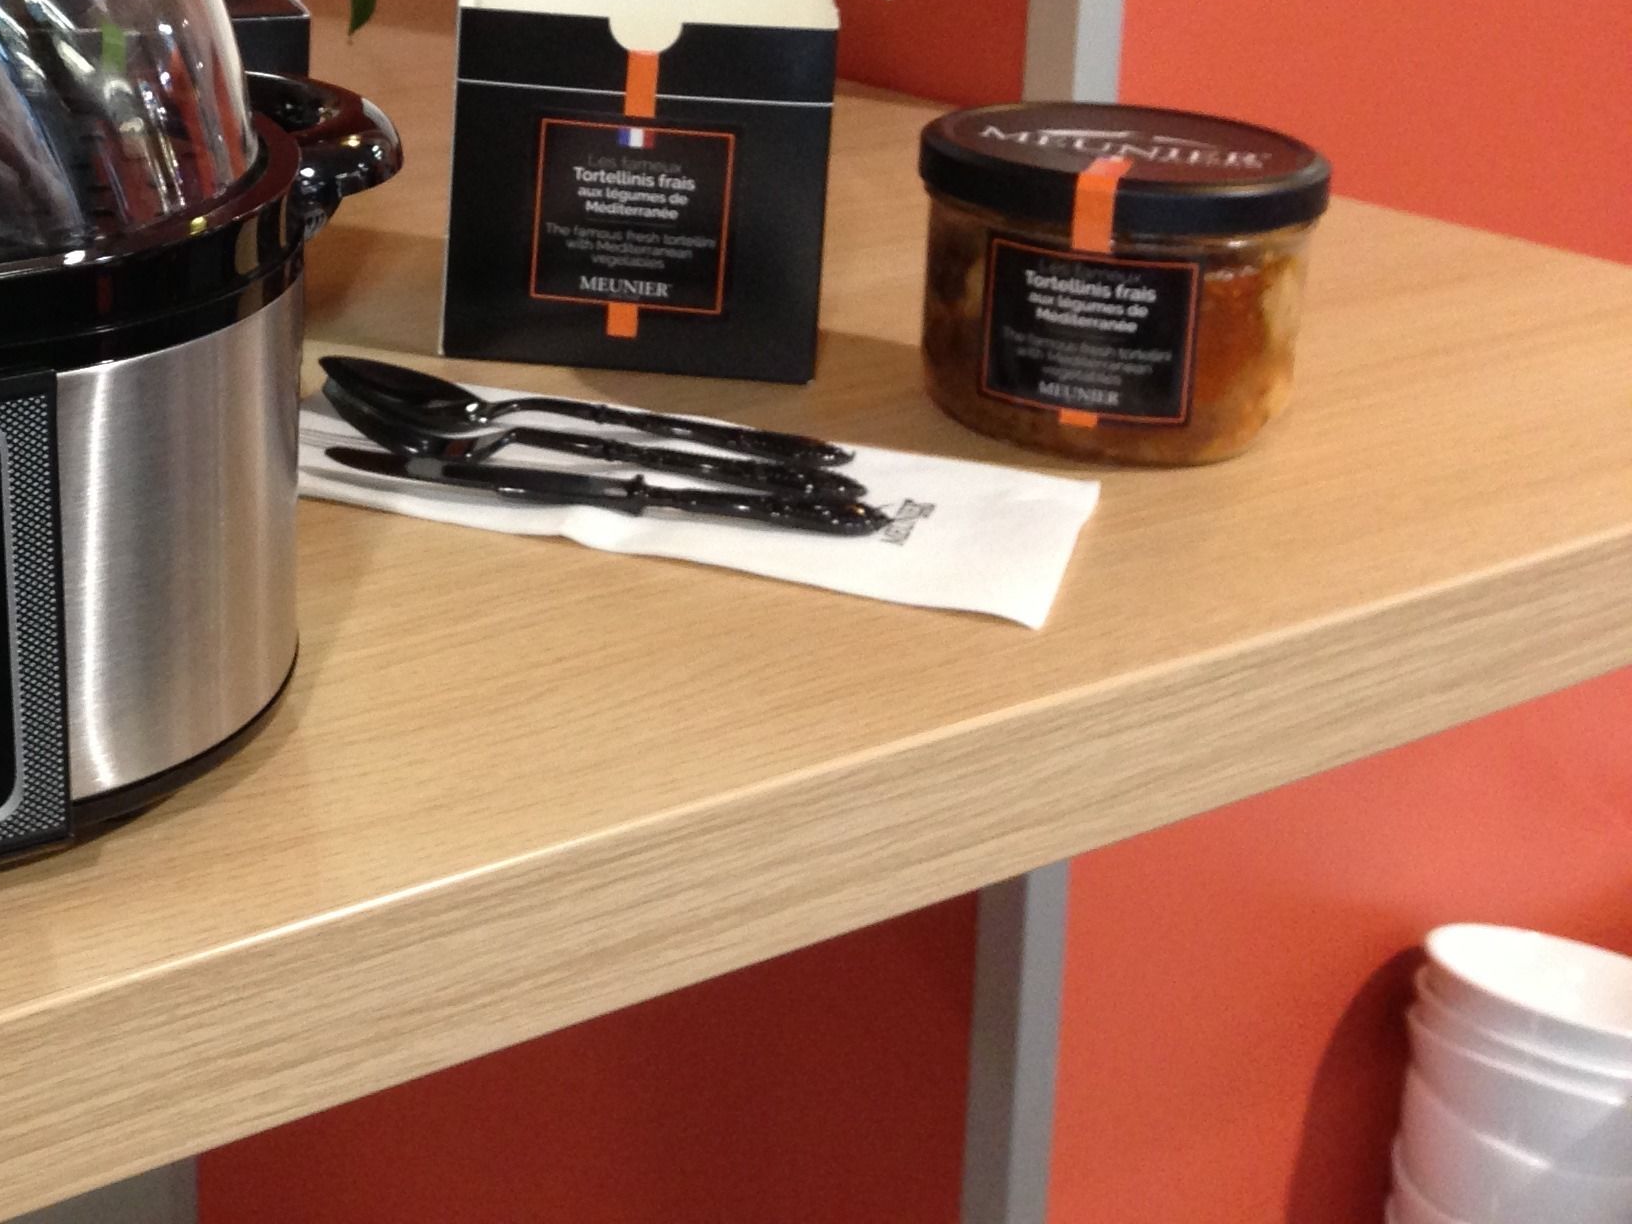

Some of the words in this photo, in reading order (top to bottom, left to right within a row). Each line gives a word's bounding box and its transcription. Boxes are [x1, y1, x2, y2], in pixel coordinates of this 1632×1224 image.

[573, 166, 654, 188] Tortellinis
[658, 174, 696, 192] frais
[578, 187, 602, 198] aux
[669, 193, 689, 206] de
[579, 276, 669, 298] MEUNIER
[1025, 269, 1112, 299] Tortellinis
[1115, 284, 1157, 303] frais
[1038, 380, 1119, 406] MEUNIER
